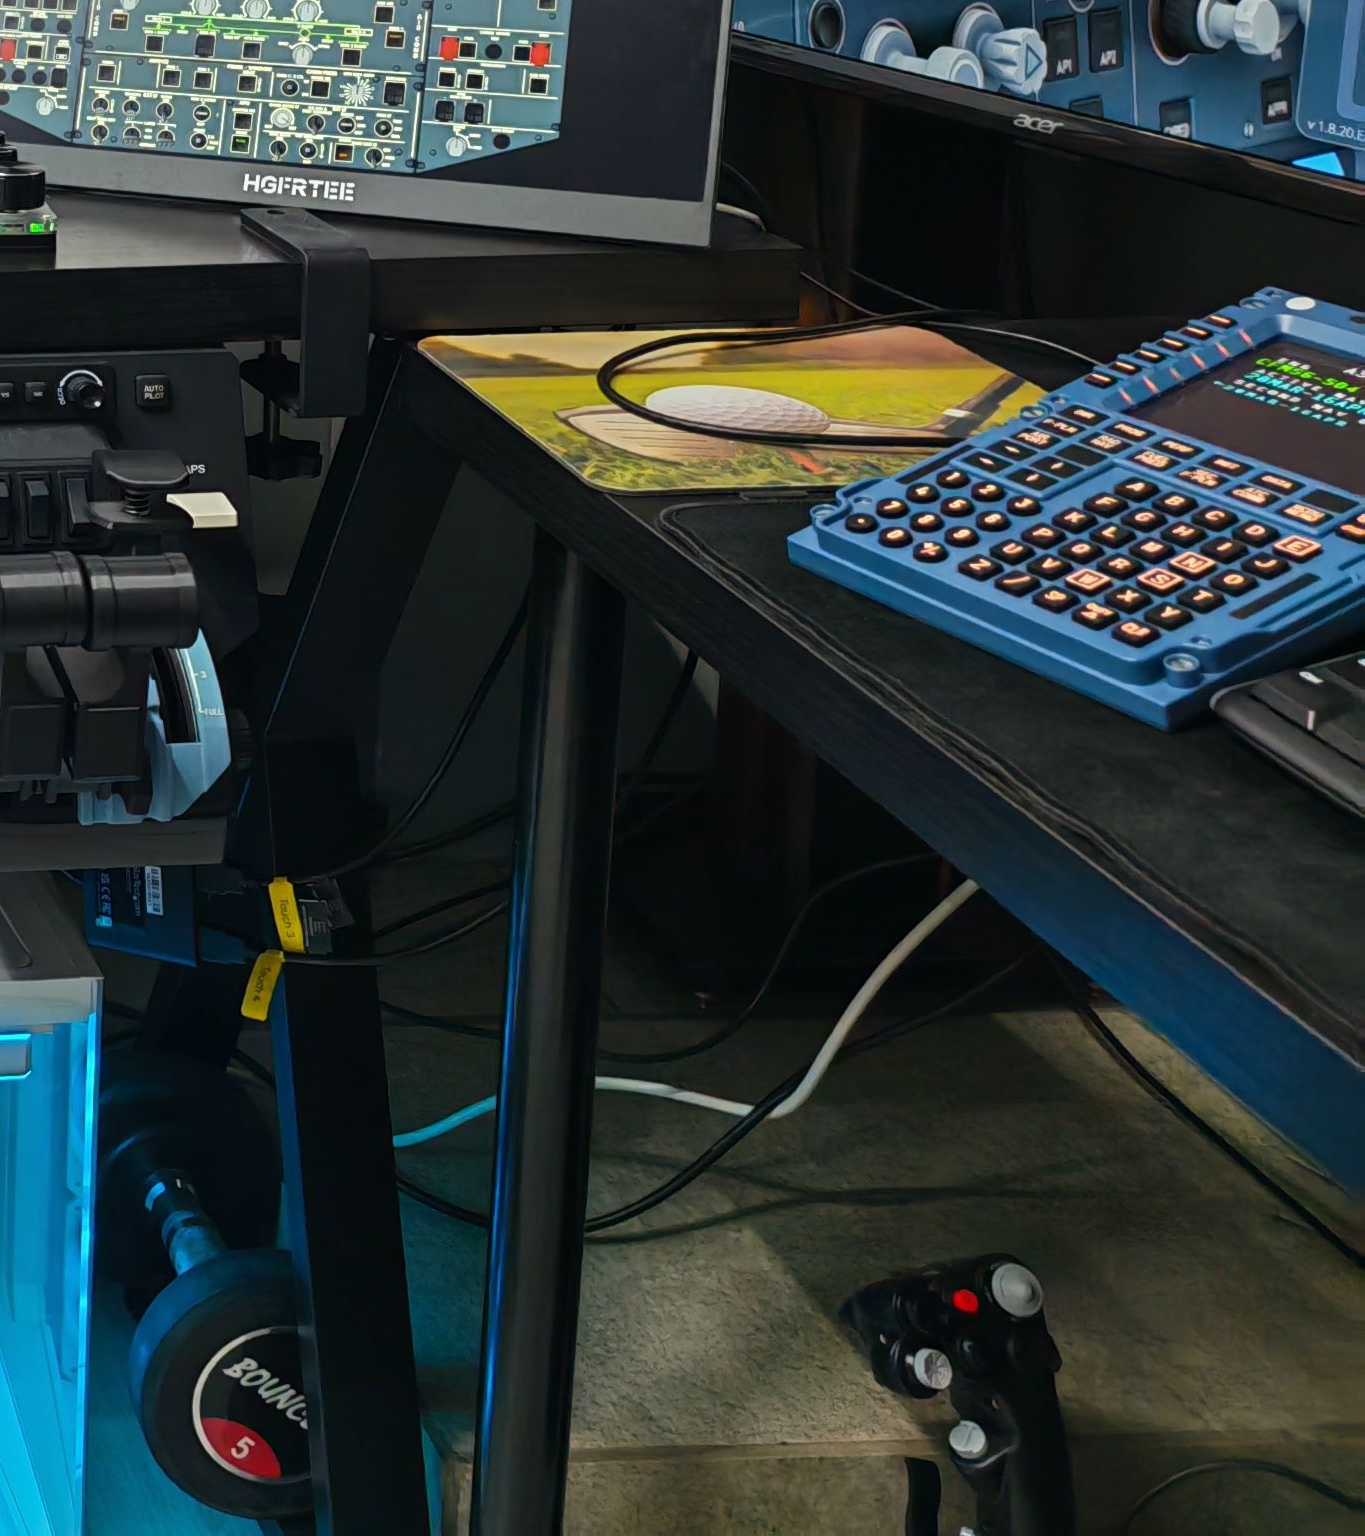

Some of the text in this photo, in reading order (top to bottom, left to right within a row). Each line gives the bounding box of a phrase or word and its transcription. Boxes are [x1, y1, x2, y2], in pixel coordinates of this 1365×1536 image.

[1013, 113, 1064, 134] acer
[144, 384, 164, 393] AUTO
[144, 392, 164, 401] PILOT
[231, 1435, 256, 1460] 5
